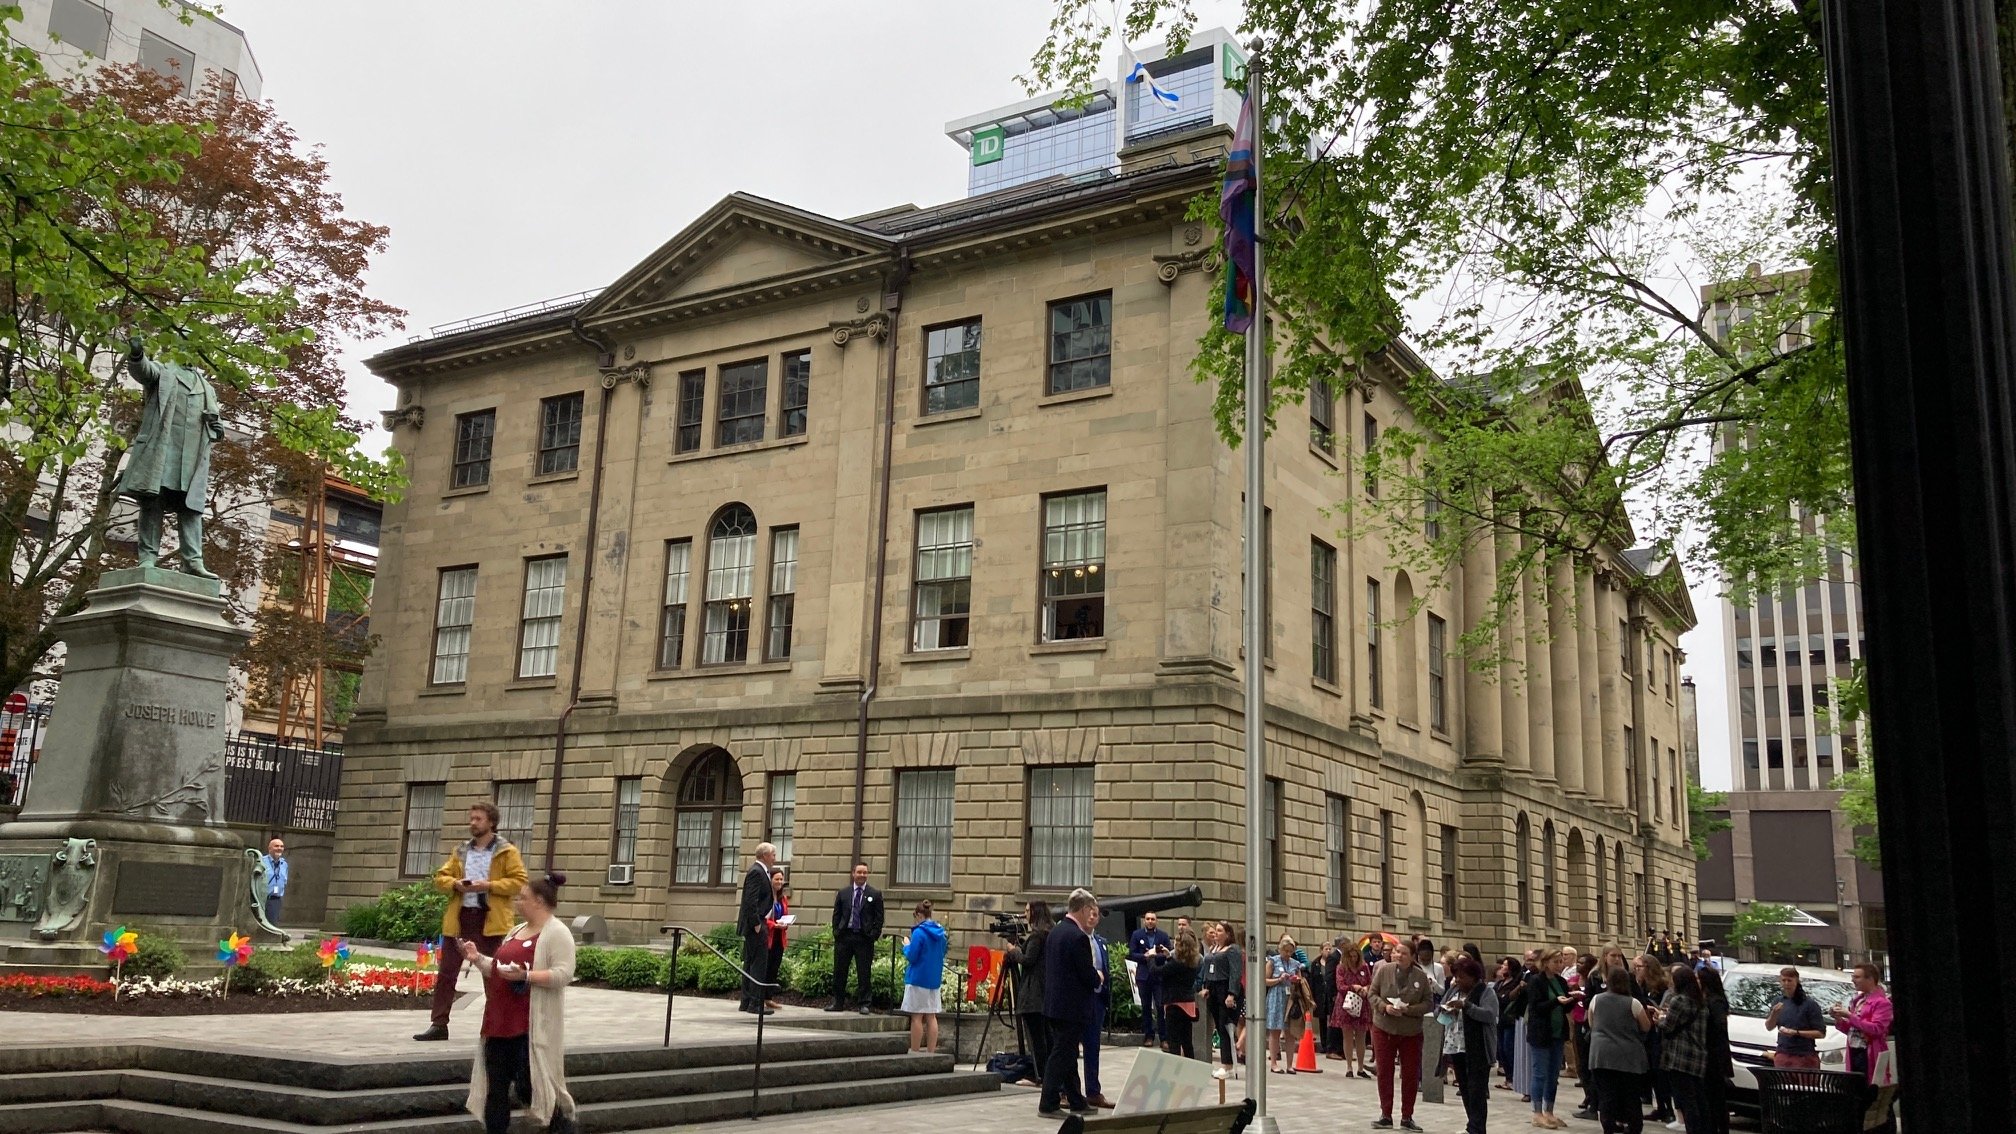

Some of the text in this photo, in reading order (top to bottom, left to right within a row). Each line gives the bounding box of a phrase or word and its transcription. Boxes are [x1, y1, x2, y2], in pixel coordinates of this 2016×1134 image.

[976, 136, 999, 156] TD
[125, 703, 216, 728] JOSEPH HOWE
[225, 745, 264, 760] IS IS THE
[225, 756, 281, 772] PRESS BLOCK
